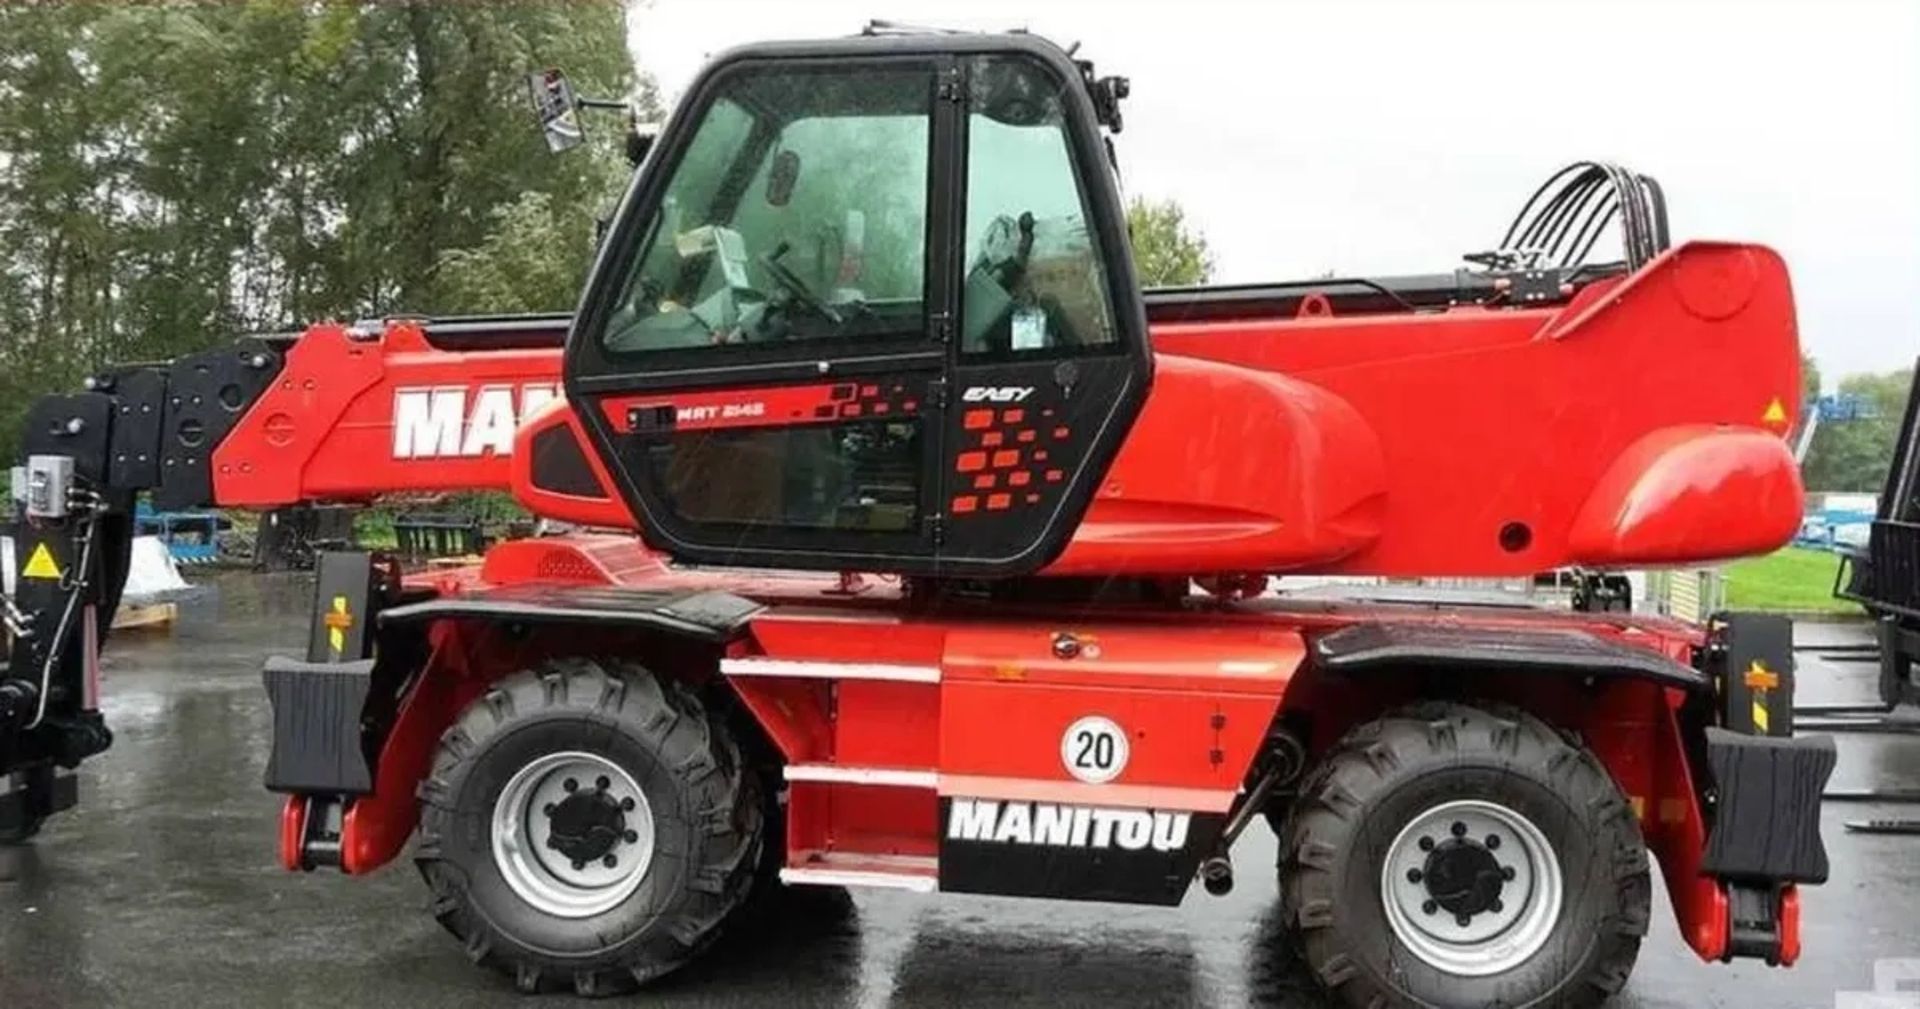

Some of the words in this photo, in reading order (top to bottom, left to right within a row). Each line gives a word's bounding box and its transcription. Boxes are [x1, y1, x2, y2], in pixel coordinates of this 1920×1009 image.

[962, 386, 1034, 401] EASY
[676, 407, 719, 421] MRT
[1075, 731, 1114, 769] 20
[949, 799, 1192, 851] MANITOU
